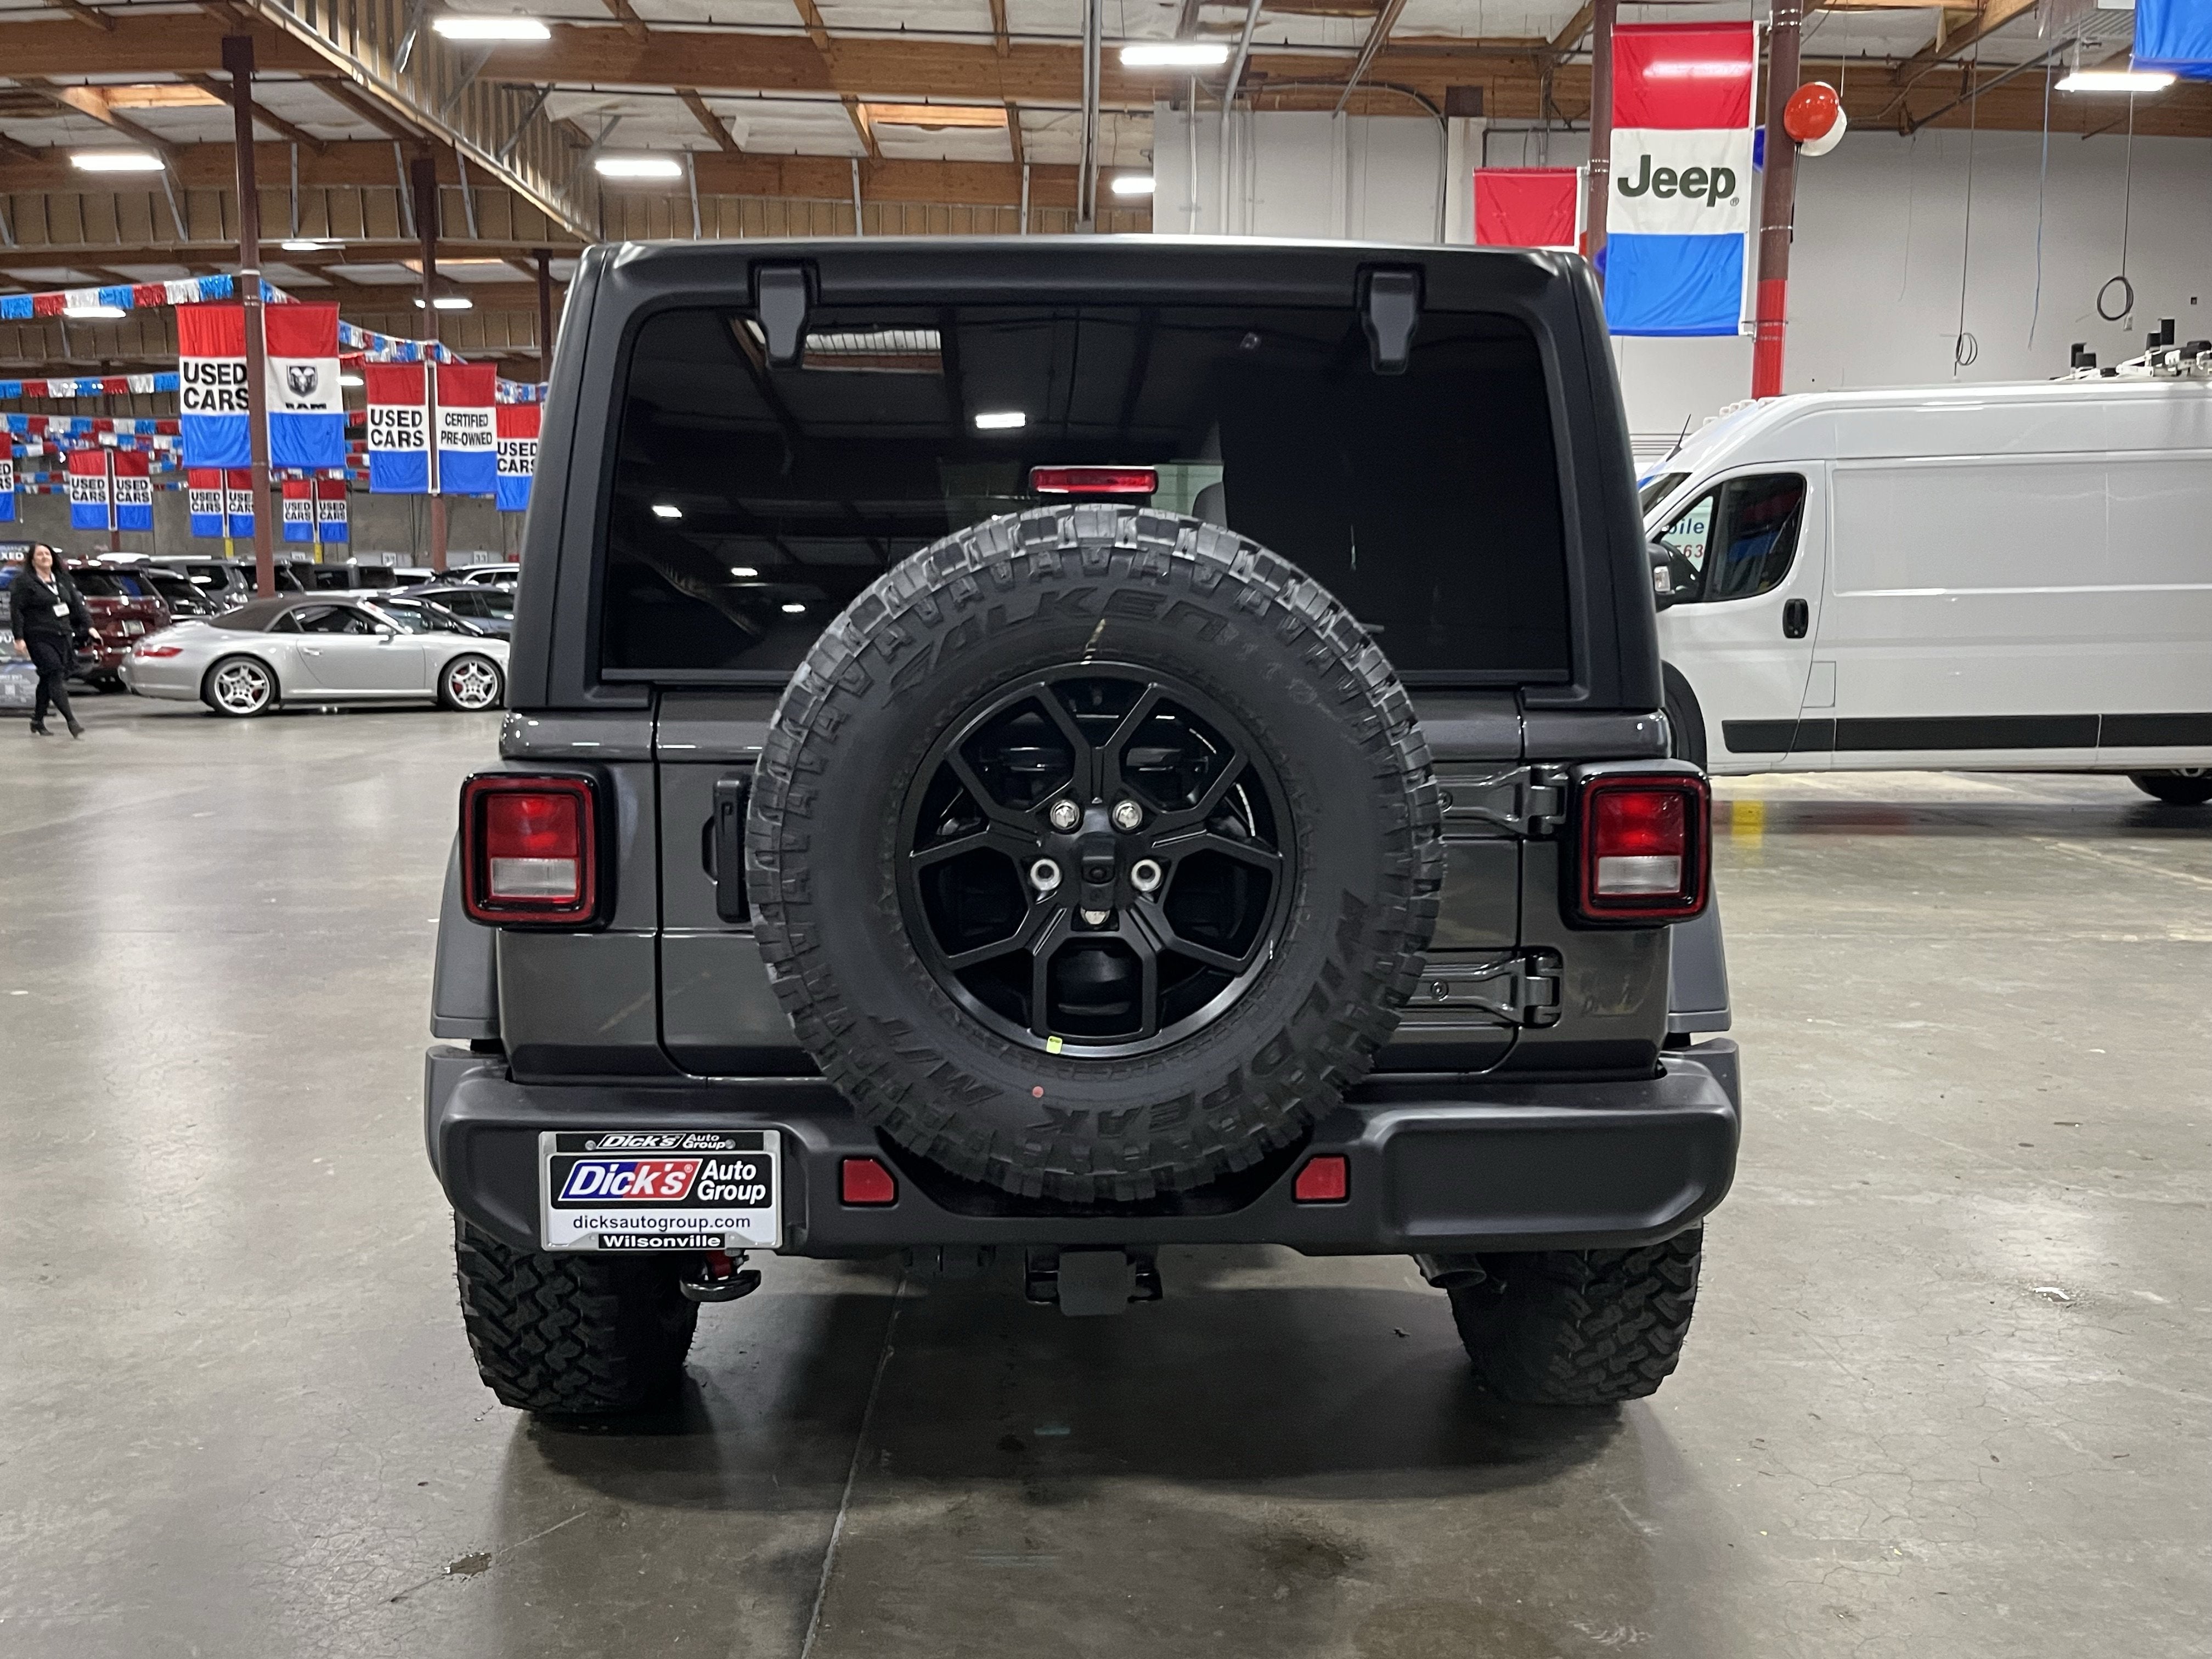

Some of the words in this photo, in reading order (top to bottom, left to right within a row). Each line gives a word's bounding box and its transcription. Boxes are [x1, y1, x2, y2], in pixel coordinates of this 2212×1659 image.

[1617, 154, 1736, 207] Jeep
[183, 362, 247, 385] USED
[183, 387, 249, 411] CARS
[371, 408, 423, 427] USED
[445, 413, 488, 427] CERTIFIED
[371, 429, 425, 448] CARS
[441, 430, 493, 446] PRE-OWNED
[497, 442, 537, 456] USED
[72, 478, 105, 490] USED
[116, 479, 148, 490] USED
[72, 490, 106, 502] CARS
[116, 492, 150, 503] CARS
[191, 492, 220, 501] USED
[229, 492, 252, 502] USE
[191, 503, 221, 512] CARS
[229, 503, 253, 513] CAR
[285, 501, 311, 511] USED
[319, 502, 345, 511] USED
[285, 511, 311, 521] CARS
[319, 511, 346, 521] CARS
[882, 586, 1228, 709] FALKEN
[602, 1135, 676, 1147] Dick's
[686, 1133, 720, 1142] Auto
[682, 1141, 725, 1150] Group
[568, 1163, 687, 1196] Dick's
[701, 1159, 757, 1181] Auto
[697, 1180, 766, 1205] Group
[573, 1215, 751, 1232] dicksautogroup.com
[603, 1235, 721, 1248] Wilsonville
